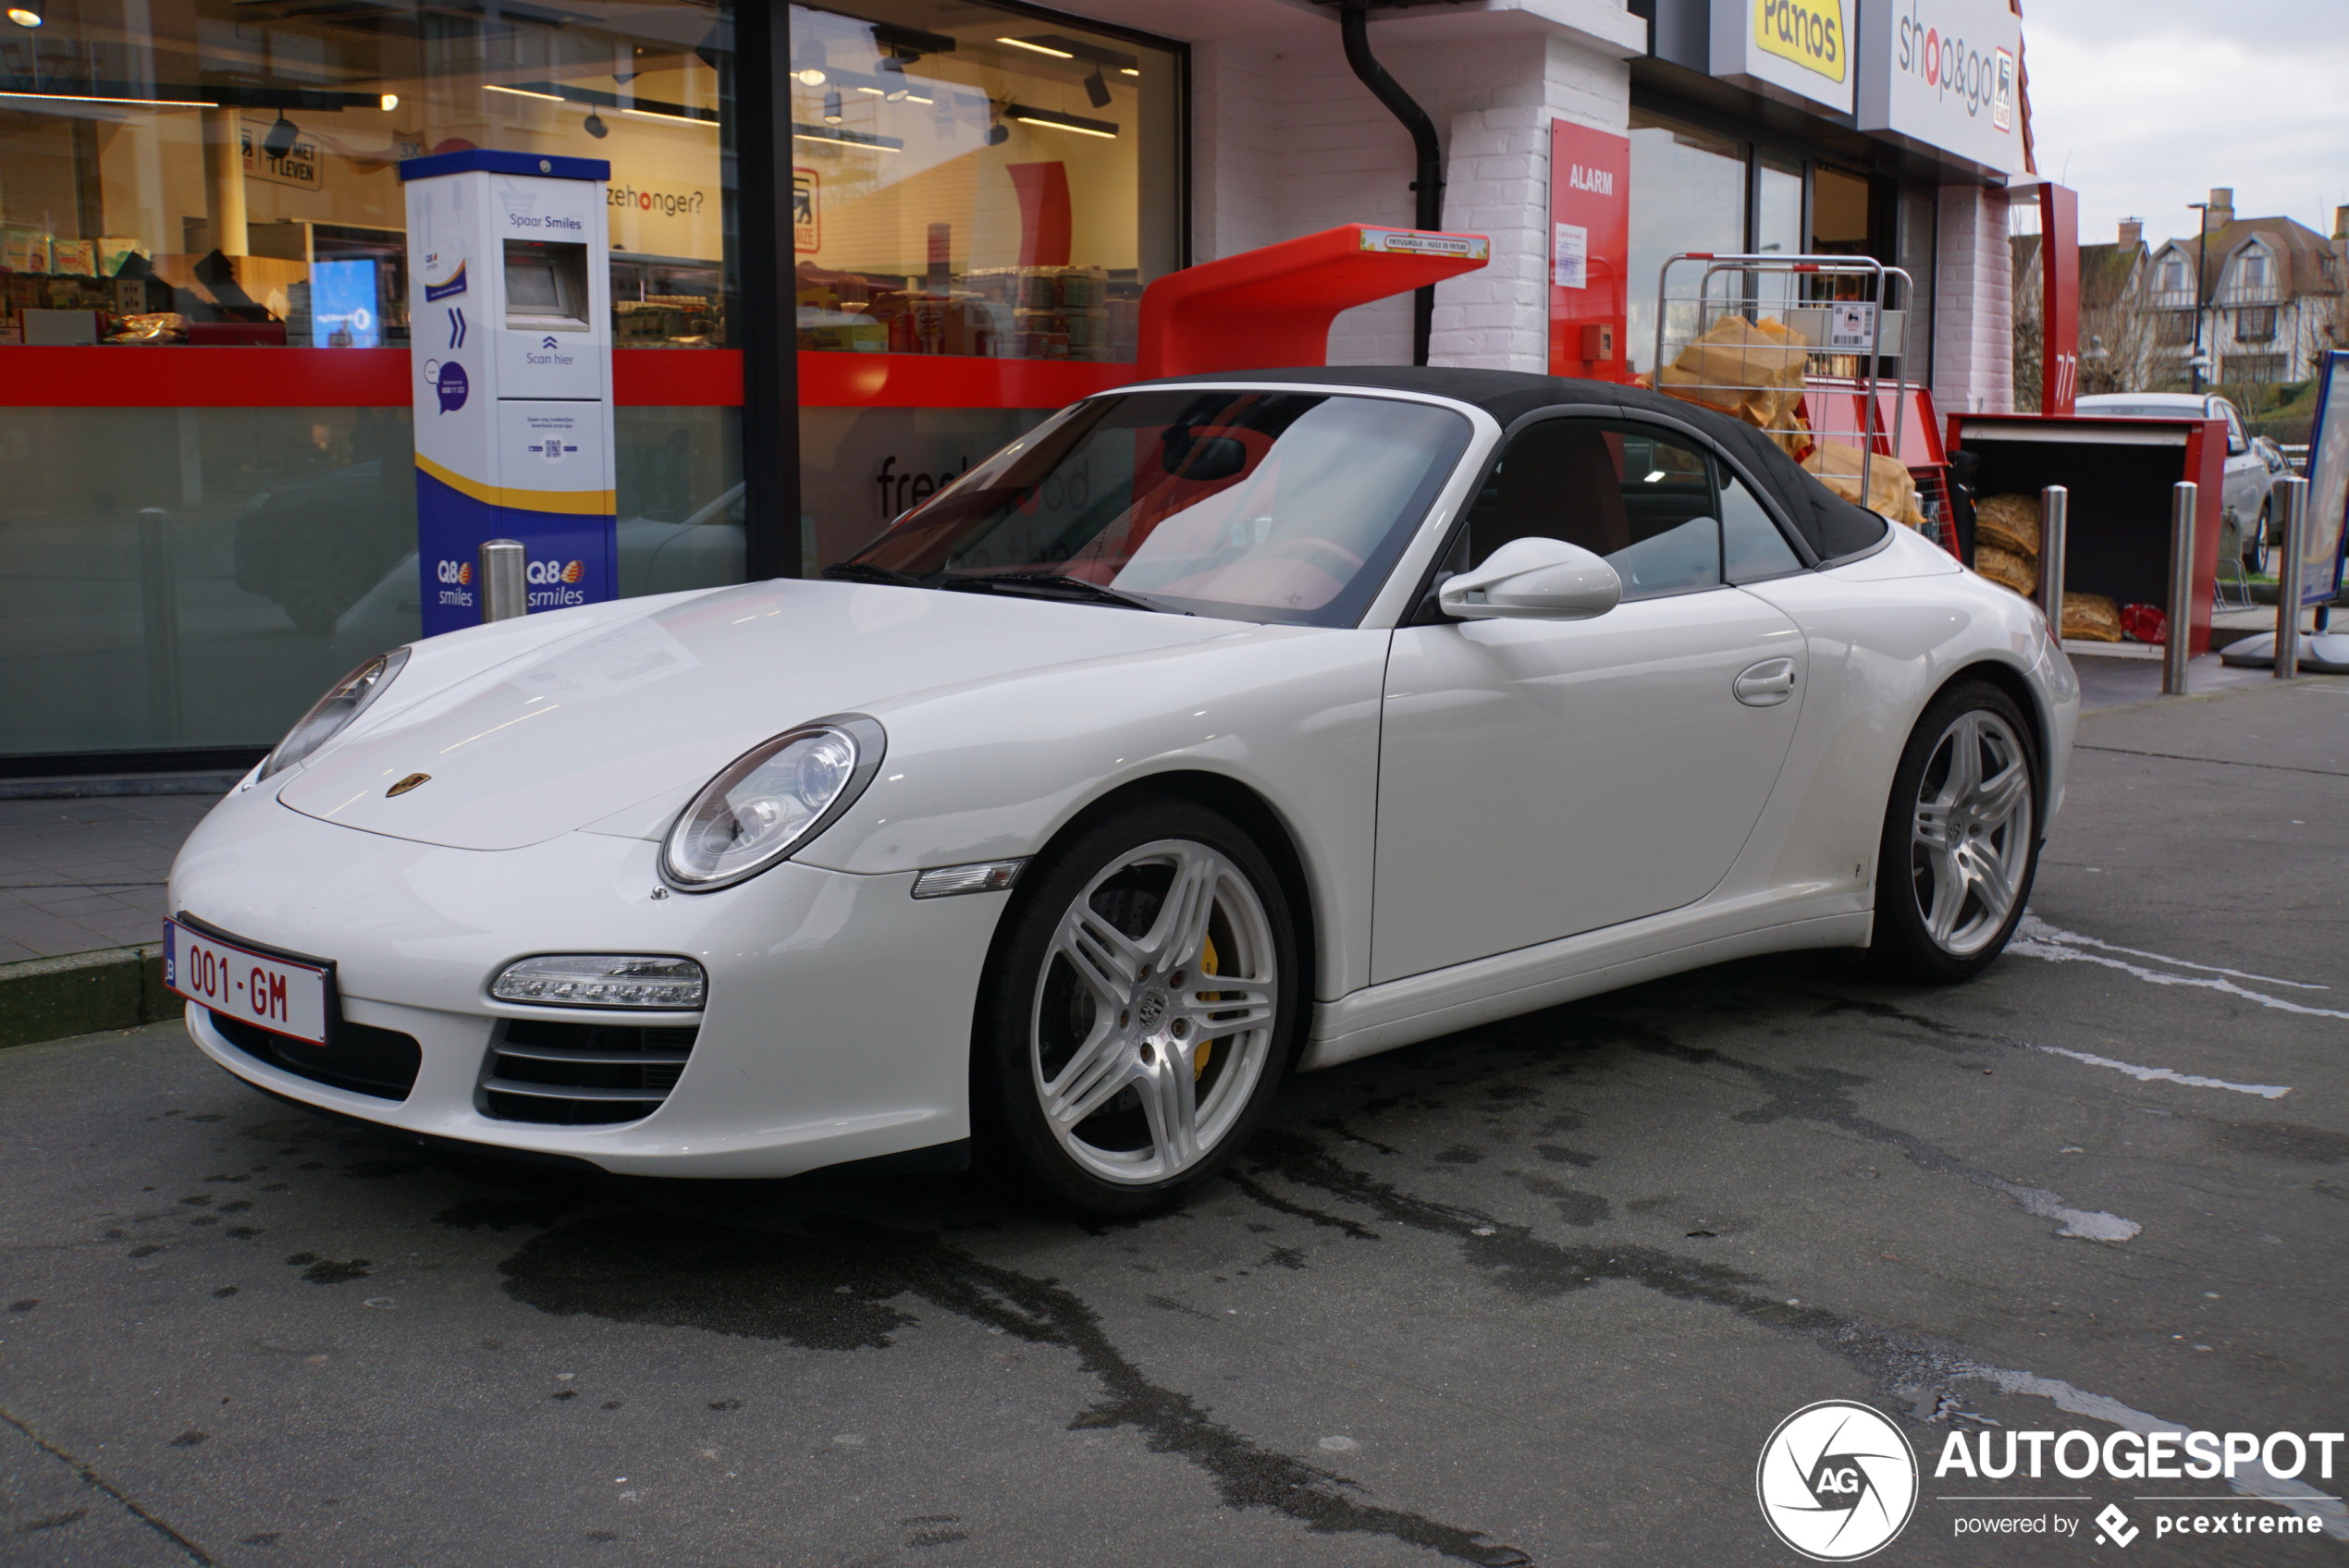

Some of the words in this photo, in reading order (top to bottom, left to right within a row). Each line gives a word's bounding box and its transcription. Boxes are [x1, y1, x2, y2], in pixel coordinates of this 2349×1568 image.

[1899, 0, 1992, 118] shop&go
[279, 159, 314, 181] LEVEN
[1570, 164, 1613, 195] ALARM
[510, 214, 542, 228] Spaar
[545, 215, 582, 229] Smiles
[1389, 238, 1423, 247] FRITUUROLIE
[526, 352, 551, 363] Scan
[554, 353, 573, 365] hier
[2057, 350, 2076, 407] 7/7
[437, 560, 458, 583] Q8
[526, 561, 560, 584] Q8
[439, 587, 473, 606] smiles
[528, 586, 584, 606] smiles
[191, 945, 287, 1023] 001-GM
